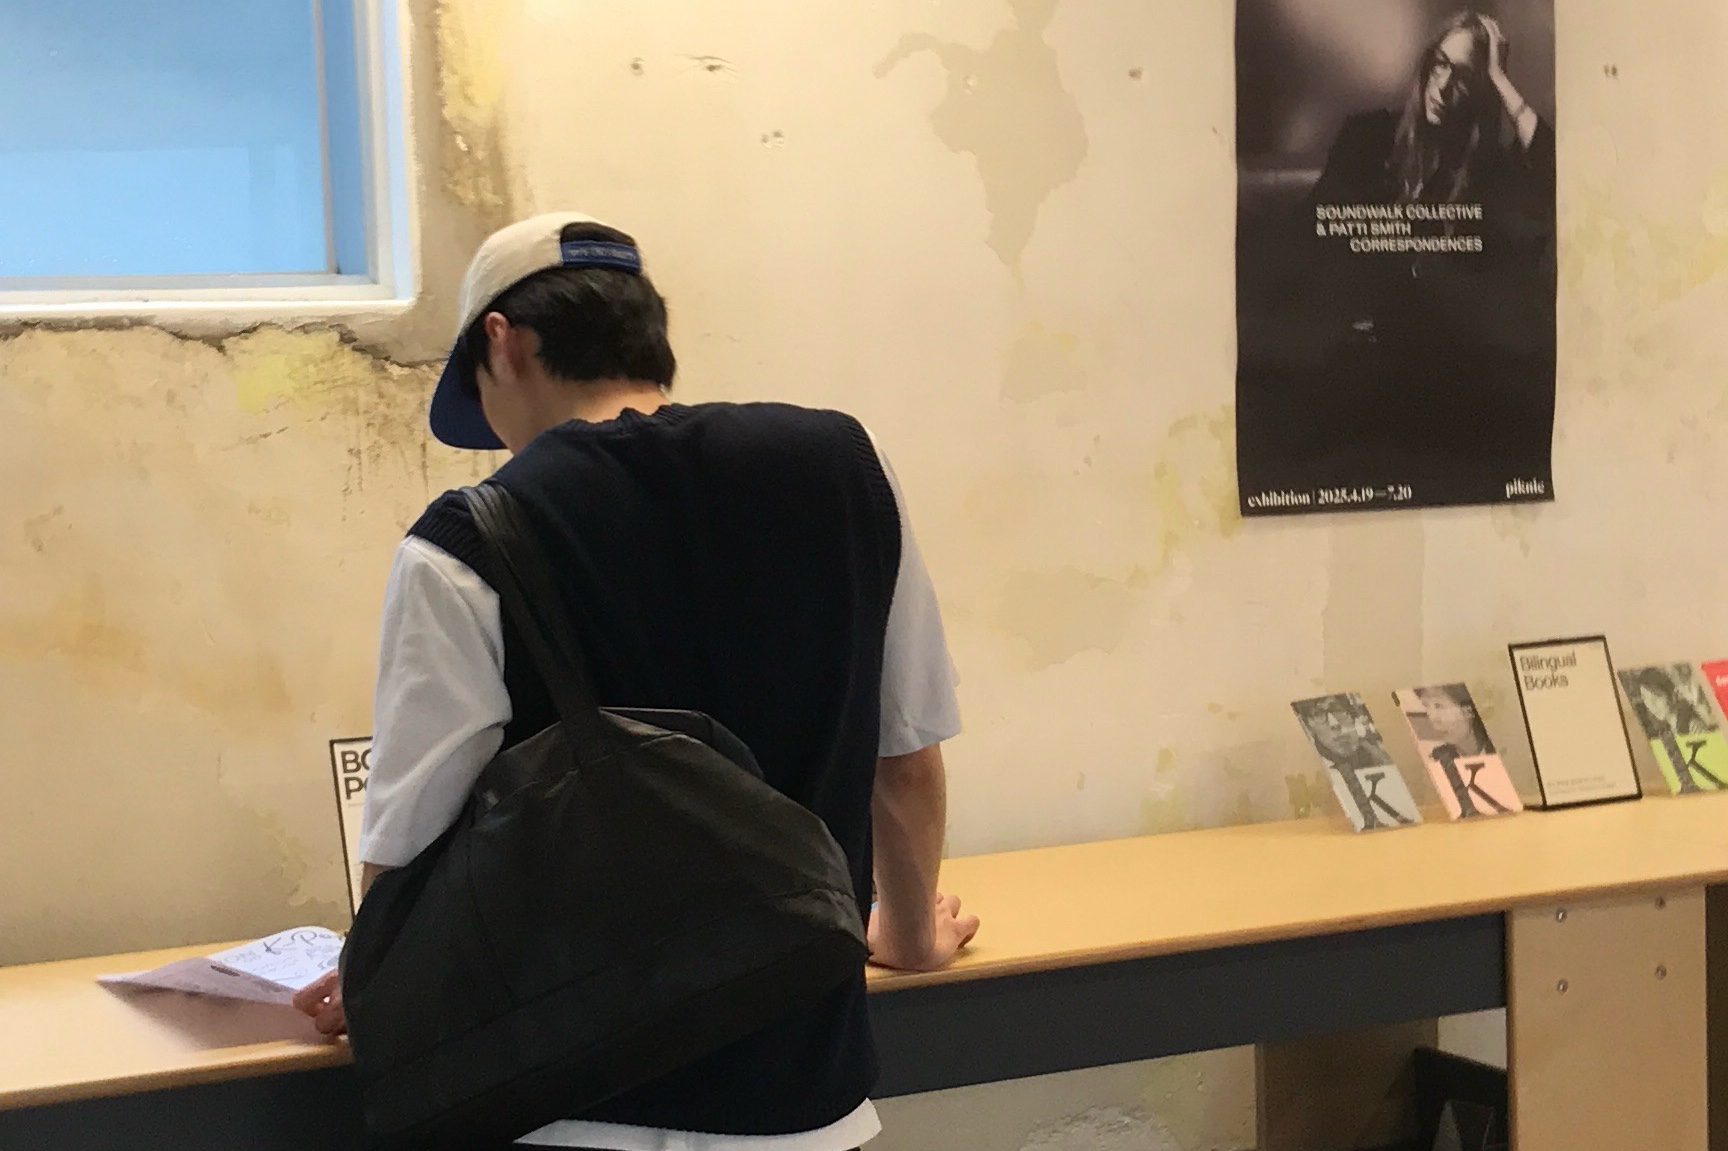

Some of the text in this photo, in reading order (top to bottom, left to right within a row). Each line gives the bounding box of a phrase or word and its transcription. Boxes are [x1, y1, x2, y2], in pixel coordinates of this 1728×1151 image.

[1316, 204, 1483, 220] SOUNDWALK COLLECTIVE
[1329, 220, 1368, 236] PATTI
[1371, 220, 1412, 236] SMITH
[1350, 236, 1483, 252] CORRESPONDENCES
[1247, 488, 1311, 508] exhibition
[1520, 651, 1577, 672] Bilingual
[1525, 673, 1569, 691] Books
[1430, 742, 1514, 819] K
